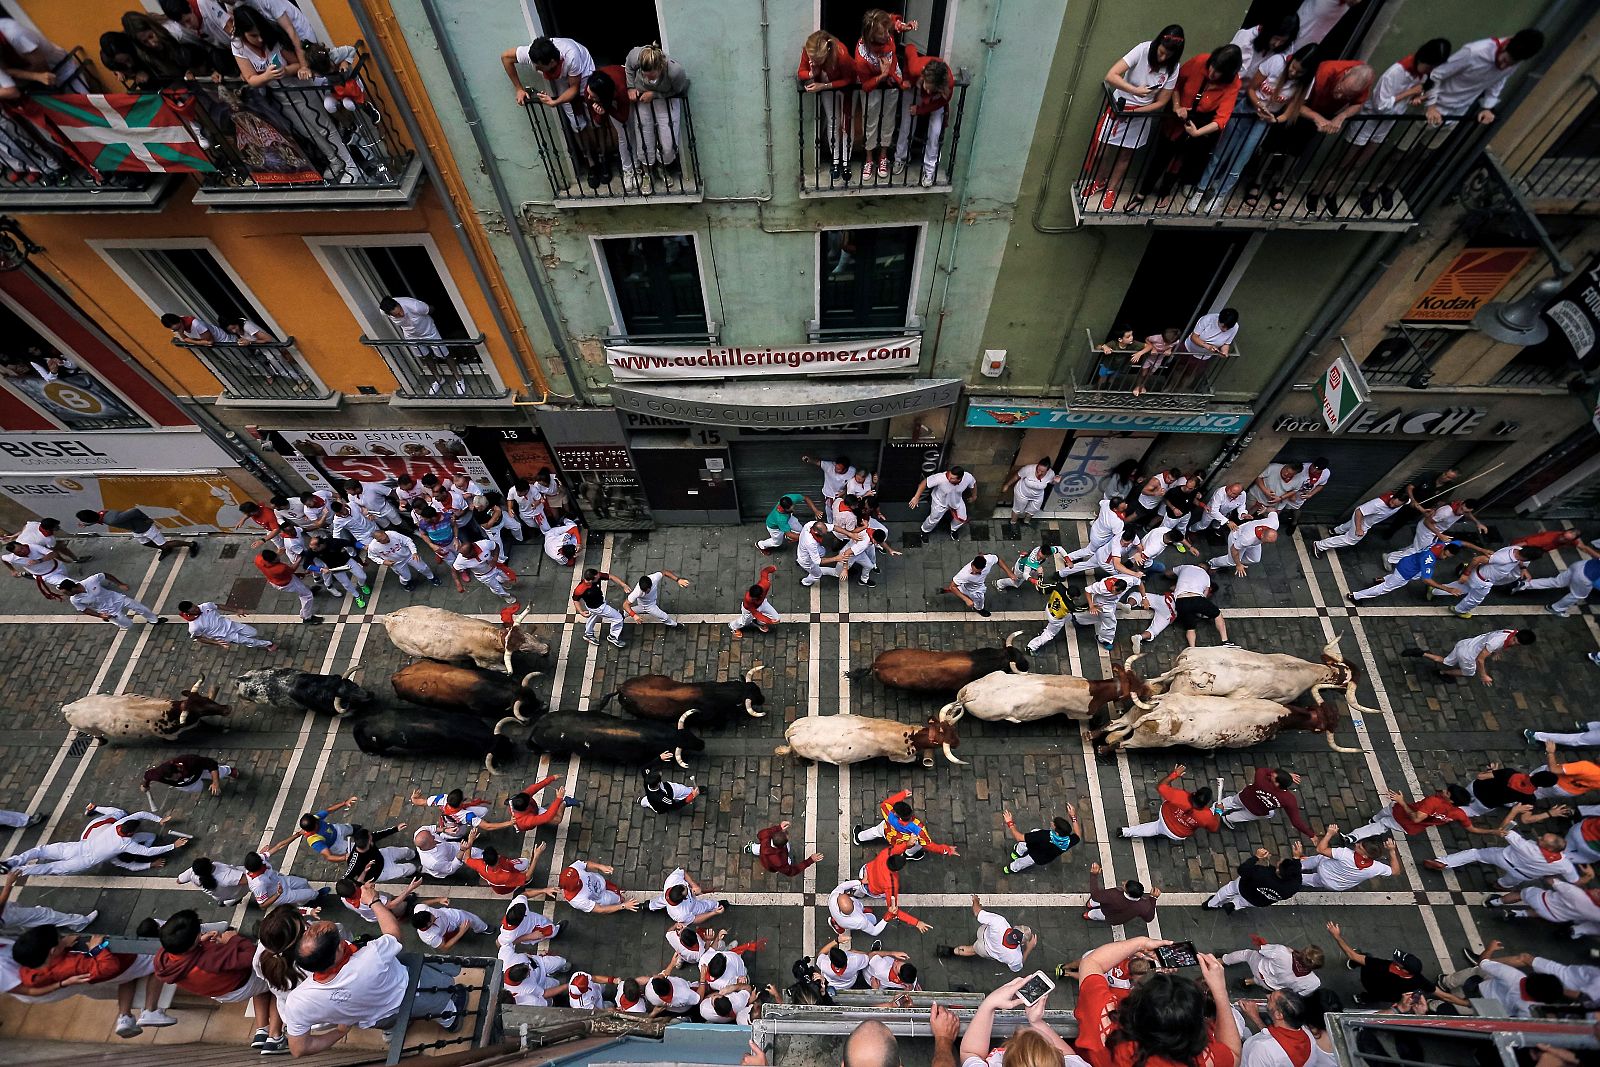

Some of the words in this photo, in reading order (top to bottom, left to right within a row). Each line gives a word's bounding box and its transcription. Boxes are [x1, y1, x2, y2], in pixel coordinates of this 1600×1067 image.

[1416, 296, 1482, 310] Kodak
[614, 345, 911, 370] www.cuchilleriagomez.com
[619, 394, 640, 408] 15
[648, 401, 717, 420] GOMEZ
[723, 408, 846, 422] CUCHILLERIA
[853, 395, 921, 417] GOMEZ
[932, 390, 950, 403] 15
[1050, 411, 1239, 427] TODOCHINO
[1347, 408, 1487, 434] EACHE
[307, 432, 358, 441] KEBAB
[501, 430, 518, 439] 13
[698, 430, 721, 444] 15
[0, 440, 108, 457] BISEL
[2, 485, 70, 494] BISEL
